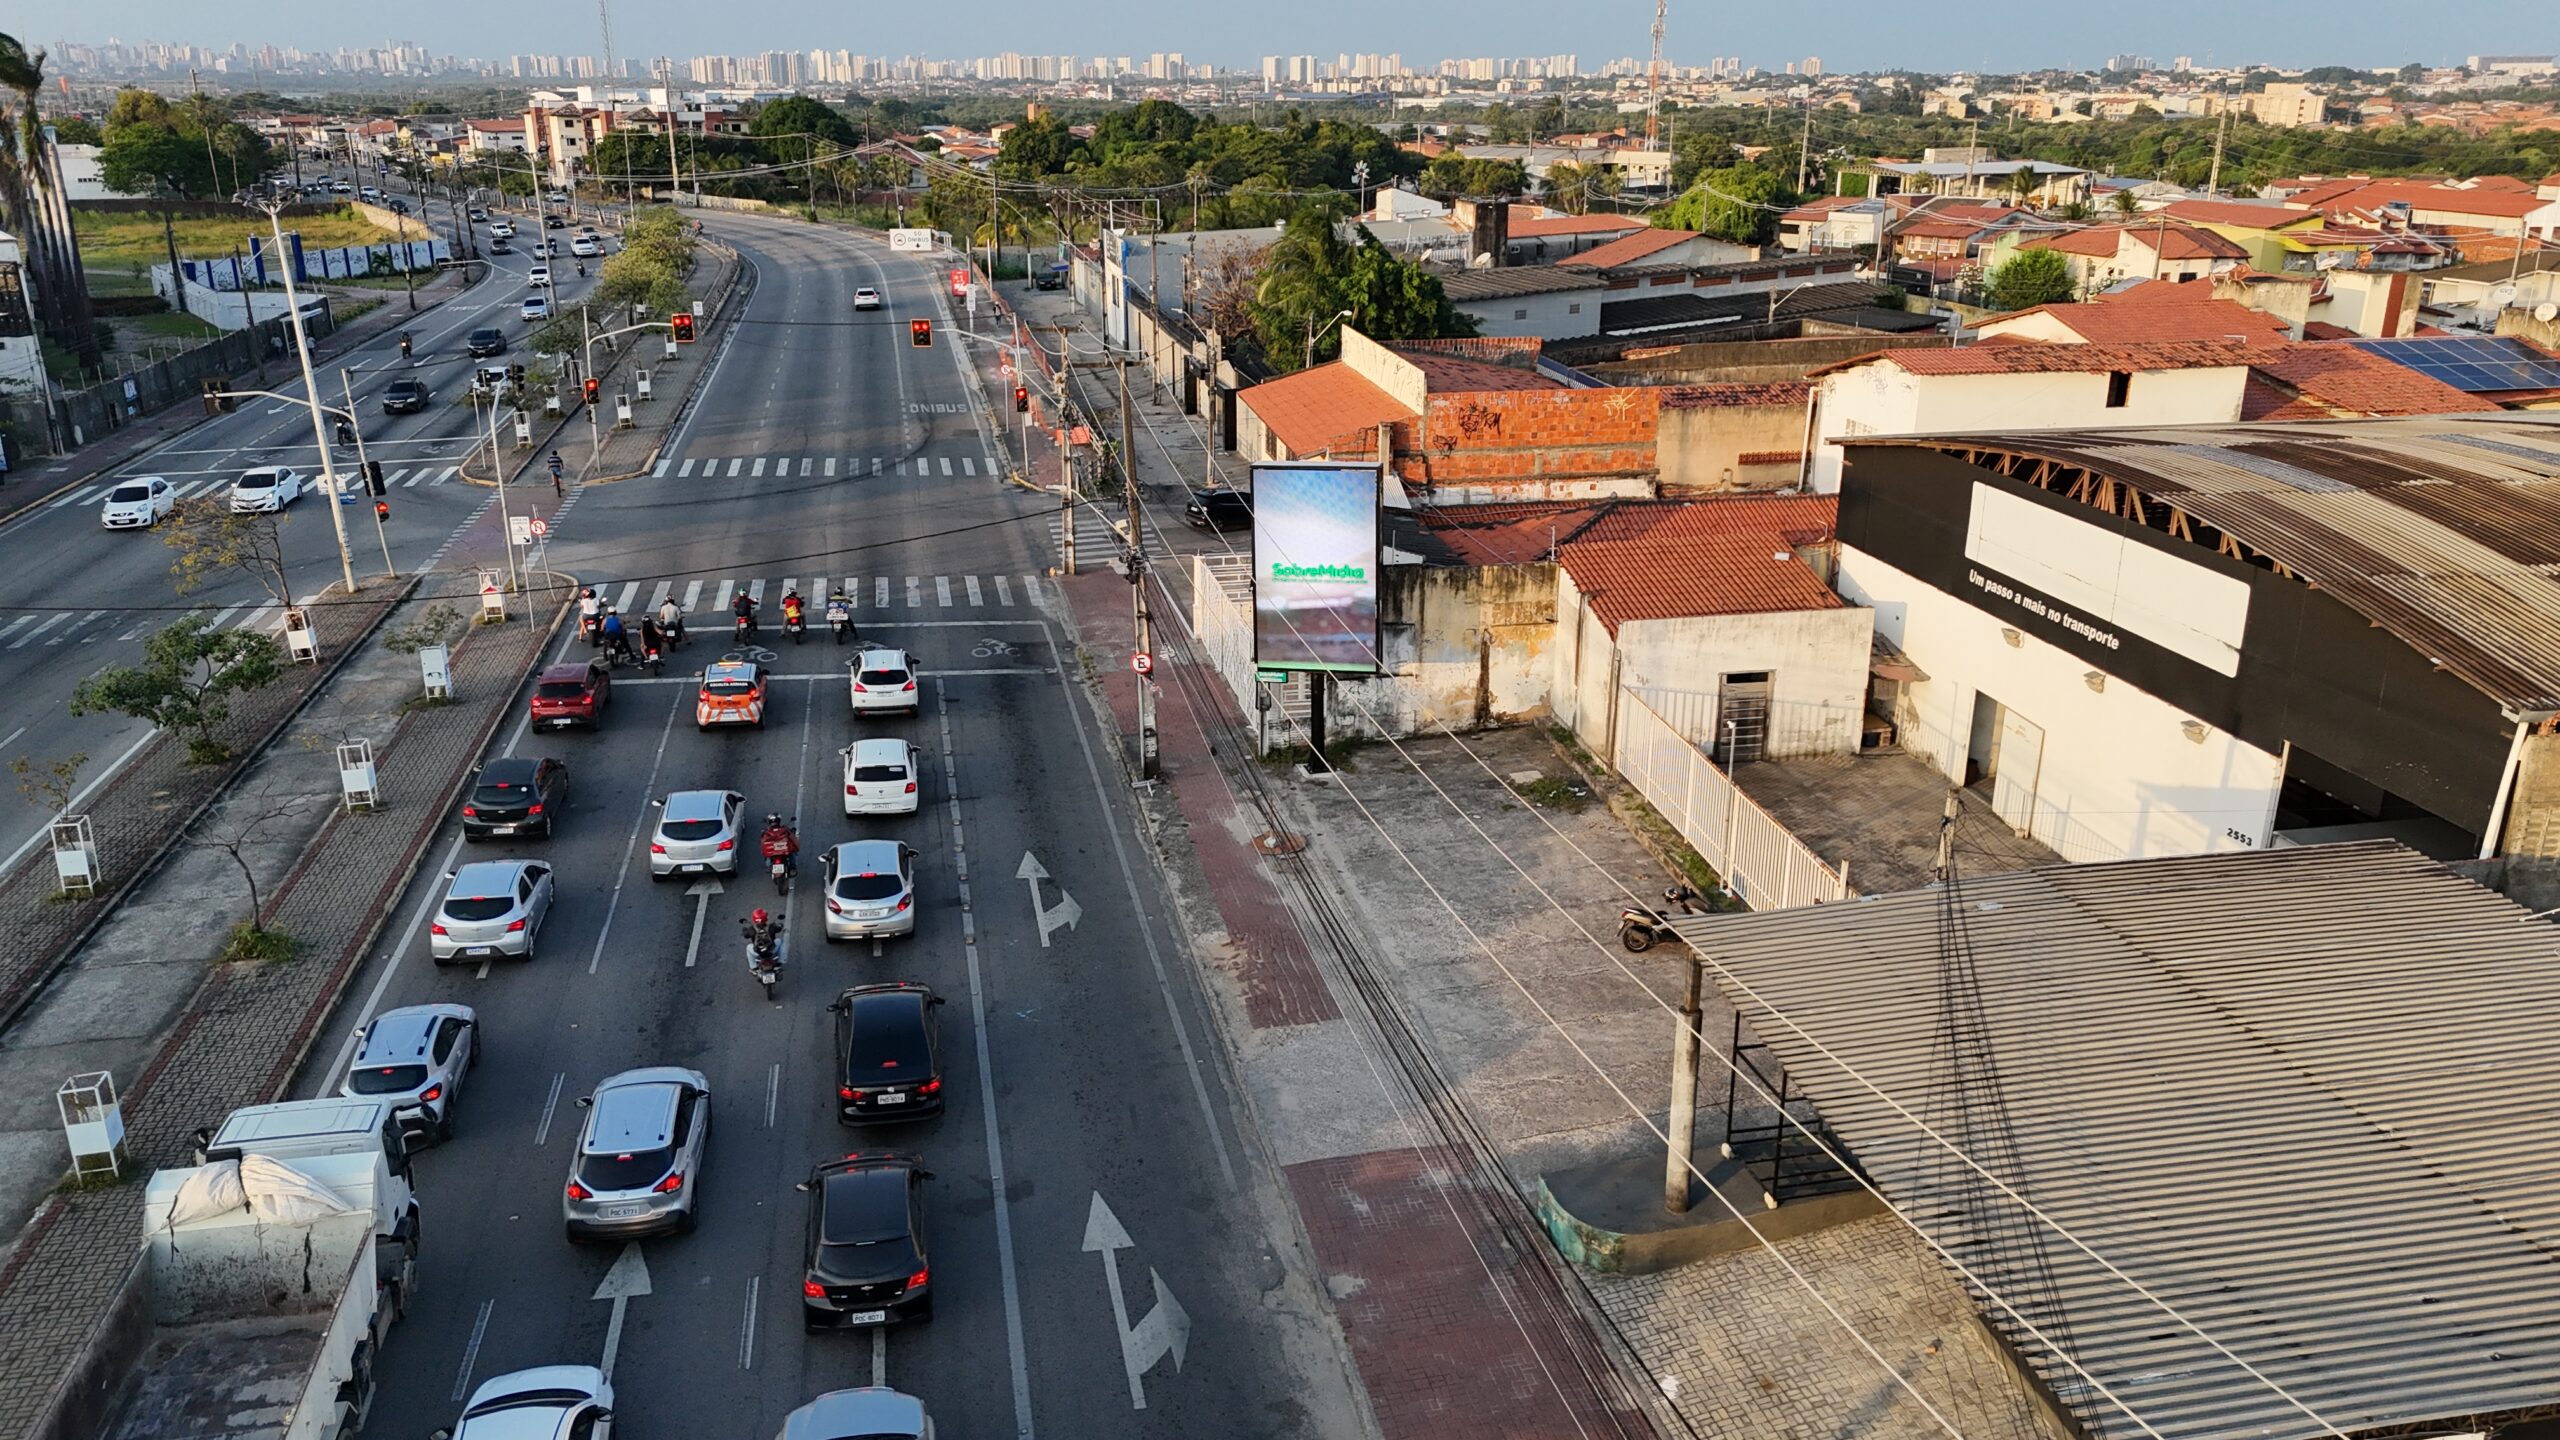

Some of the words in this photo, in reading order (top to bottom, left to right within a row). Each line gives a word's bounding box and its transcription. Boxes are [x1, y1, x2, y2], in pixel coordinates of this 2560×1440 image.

[1969, 568, 1985, 588] Um
[1984, 579, 2013, 600] passo
[2014, 593, 2021, 604] a
[2022, 596, 2047, 616] mais
[2047, 608, 2061, 623] no
[2062, 613, 2120, 650] transporte
[2227, 827, 2252, 846] 2553
